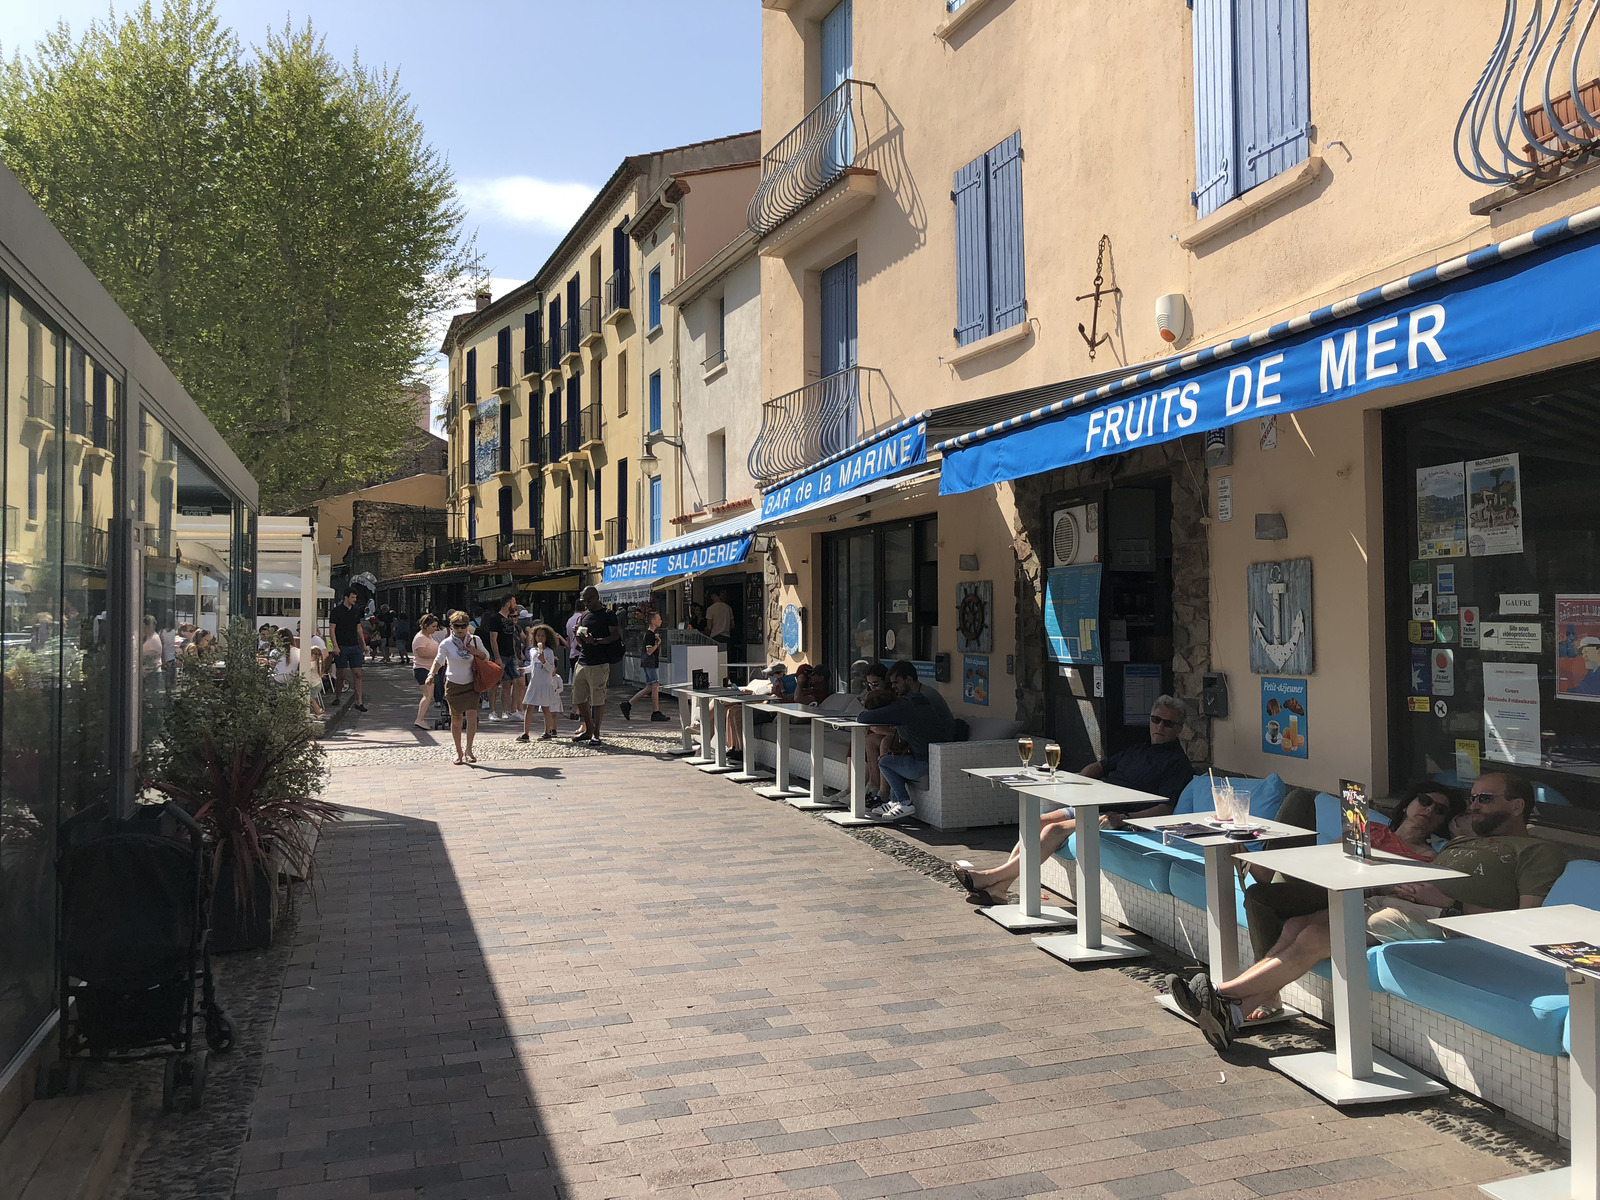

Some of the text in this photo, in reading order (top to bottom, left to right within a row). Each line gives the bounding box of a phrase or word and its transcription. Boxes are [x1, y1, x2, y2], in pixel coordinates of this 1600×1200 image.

[1085, 303, 1447, 454] FRUITS DE MER
[764, 434, 912, 516] BAR de la MARINE
[610, 540, 739, 579] CREPERIE SALADERIE
[1505, 599, 1533, 607] GAUFRE
[1559, 607, 1571, 623] BAR
[1573, 605, 1580, 616] DE
[1502, 630, 1537, 638] vidéoprotection
[1264, 682, 1303, 694] Petit-déjeuner
